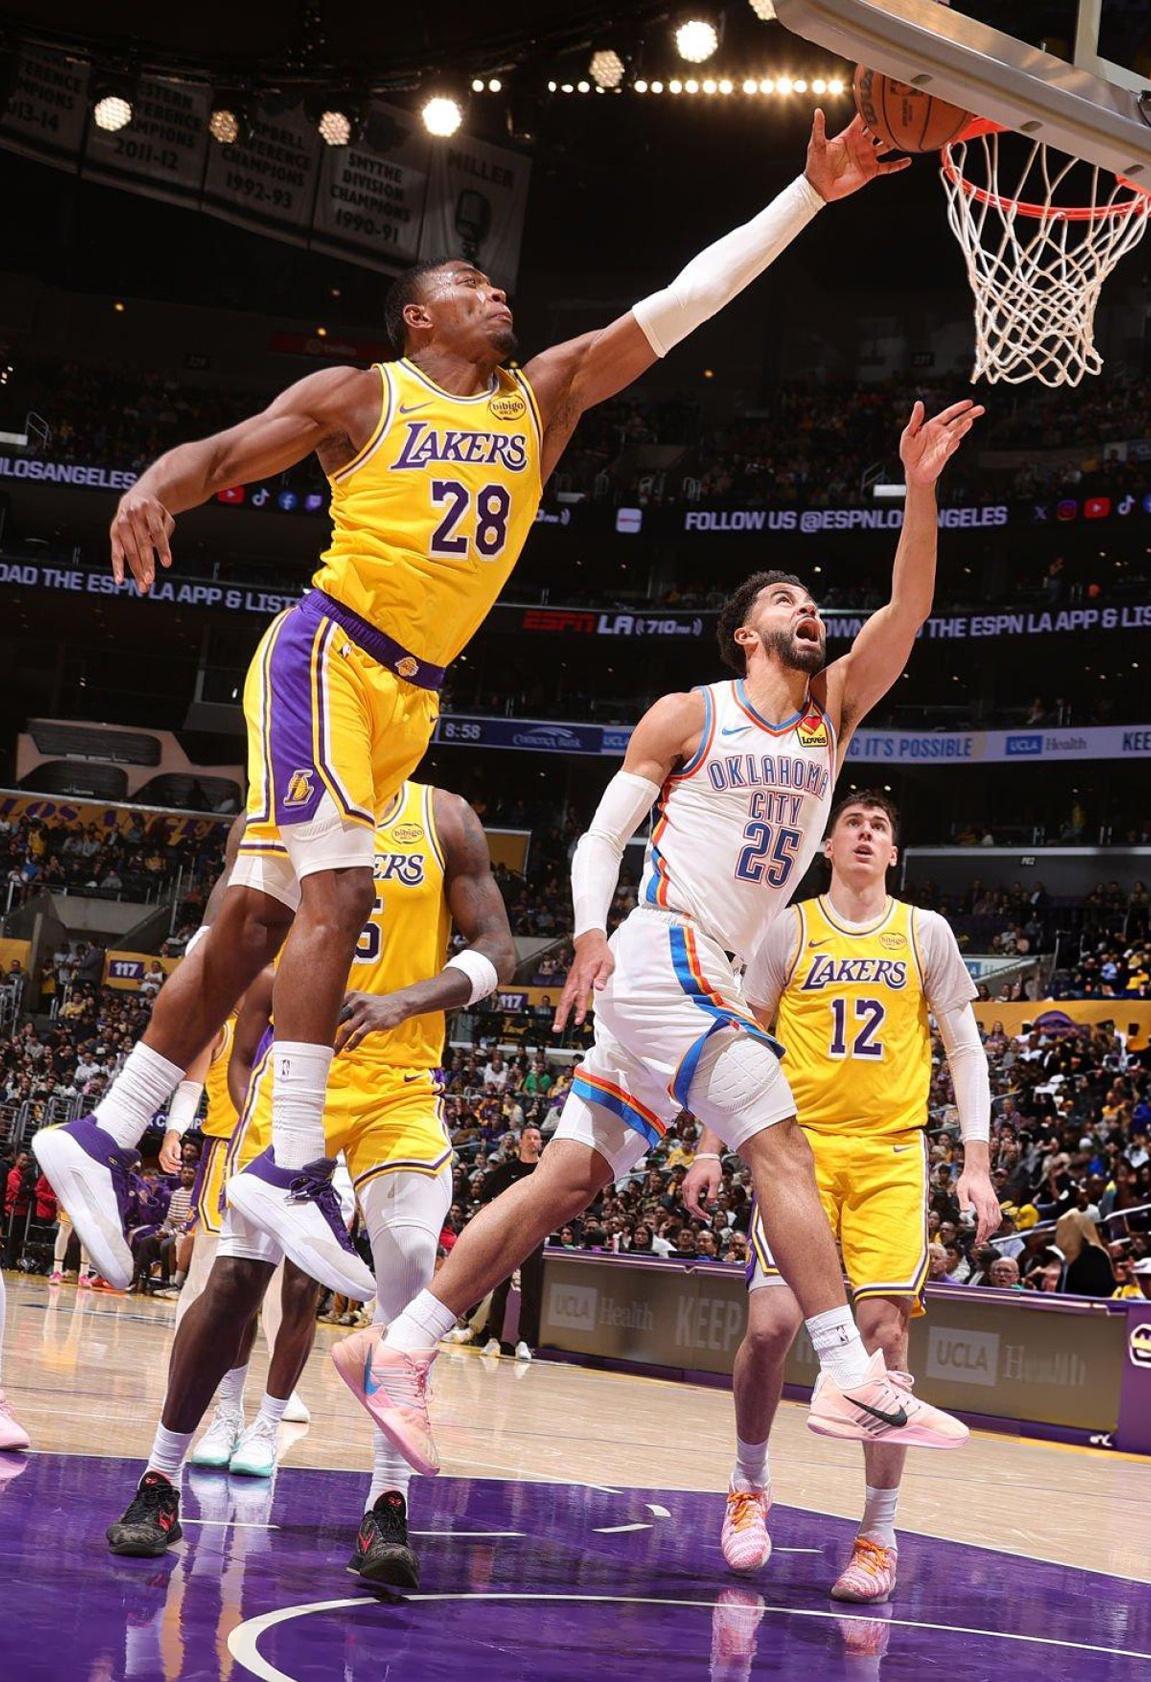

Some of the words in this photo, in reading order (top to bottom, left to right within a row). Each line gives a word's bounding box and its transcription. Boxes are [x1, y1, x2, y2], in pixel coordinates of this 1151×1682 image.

[114, 137, 177, 169] 2011-12
[348, 152, 402, 183] SMYTHE
[447, 148, 514, 188] MILLER
[226, 171, 292, 208] 1992-93
[343, 169, 404, 202] DIVISION
[330, 184, 411, 223] CHAMPIONS
[336, 208, 399, 243] 1990-91
[390, 422, 528, 472] LAKERS
[429, 479, 511, 561] 28
[685, 511, 766, 530] FOLLOW
[768, 511, 798, 529] US
[41, 568, 84, 590] THE
[149, 582, 174, 601] LA
[177, 585, 222, 606] APP
[225, 590, 243, 609] &
[523, 610, 594, 632] ESPN
[597, 615, 634, 634] LA
[928, 617, 966, 637] THE
[970, 614, 1024, 636] ESPN
[1028, 612, 1051, 633] LA
[1055, 609, 1098, 631] APP
[1102, 608, 1118, 628] &
[445, 723, 481, 739] 8:58
[603, 735, 627, 747] UCL
[865, 738, 894, 757] IT'S
[899, 738, 974, 757] POSSIBLE
[1009, 740, 1040, 752] UCLA
[1046, 736, 1087, 750] Health
[707, 754, 831, 800] OKLAHOMA
[749, 791, 803, 826] CITY
[373, 853, 424, 887] ERS
[734, 821, 803, 889] 25
[114, 962, 139, 977] 117
[801, 954, 907, 990] LAKERS
[500, 994, 523, 1009] 117
[829, 998, 884, 1060] 12
[675, 1296, 742, 1348] KEEP
[936, 1340, 988, 1371] UCLA
